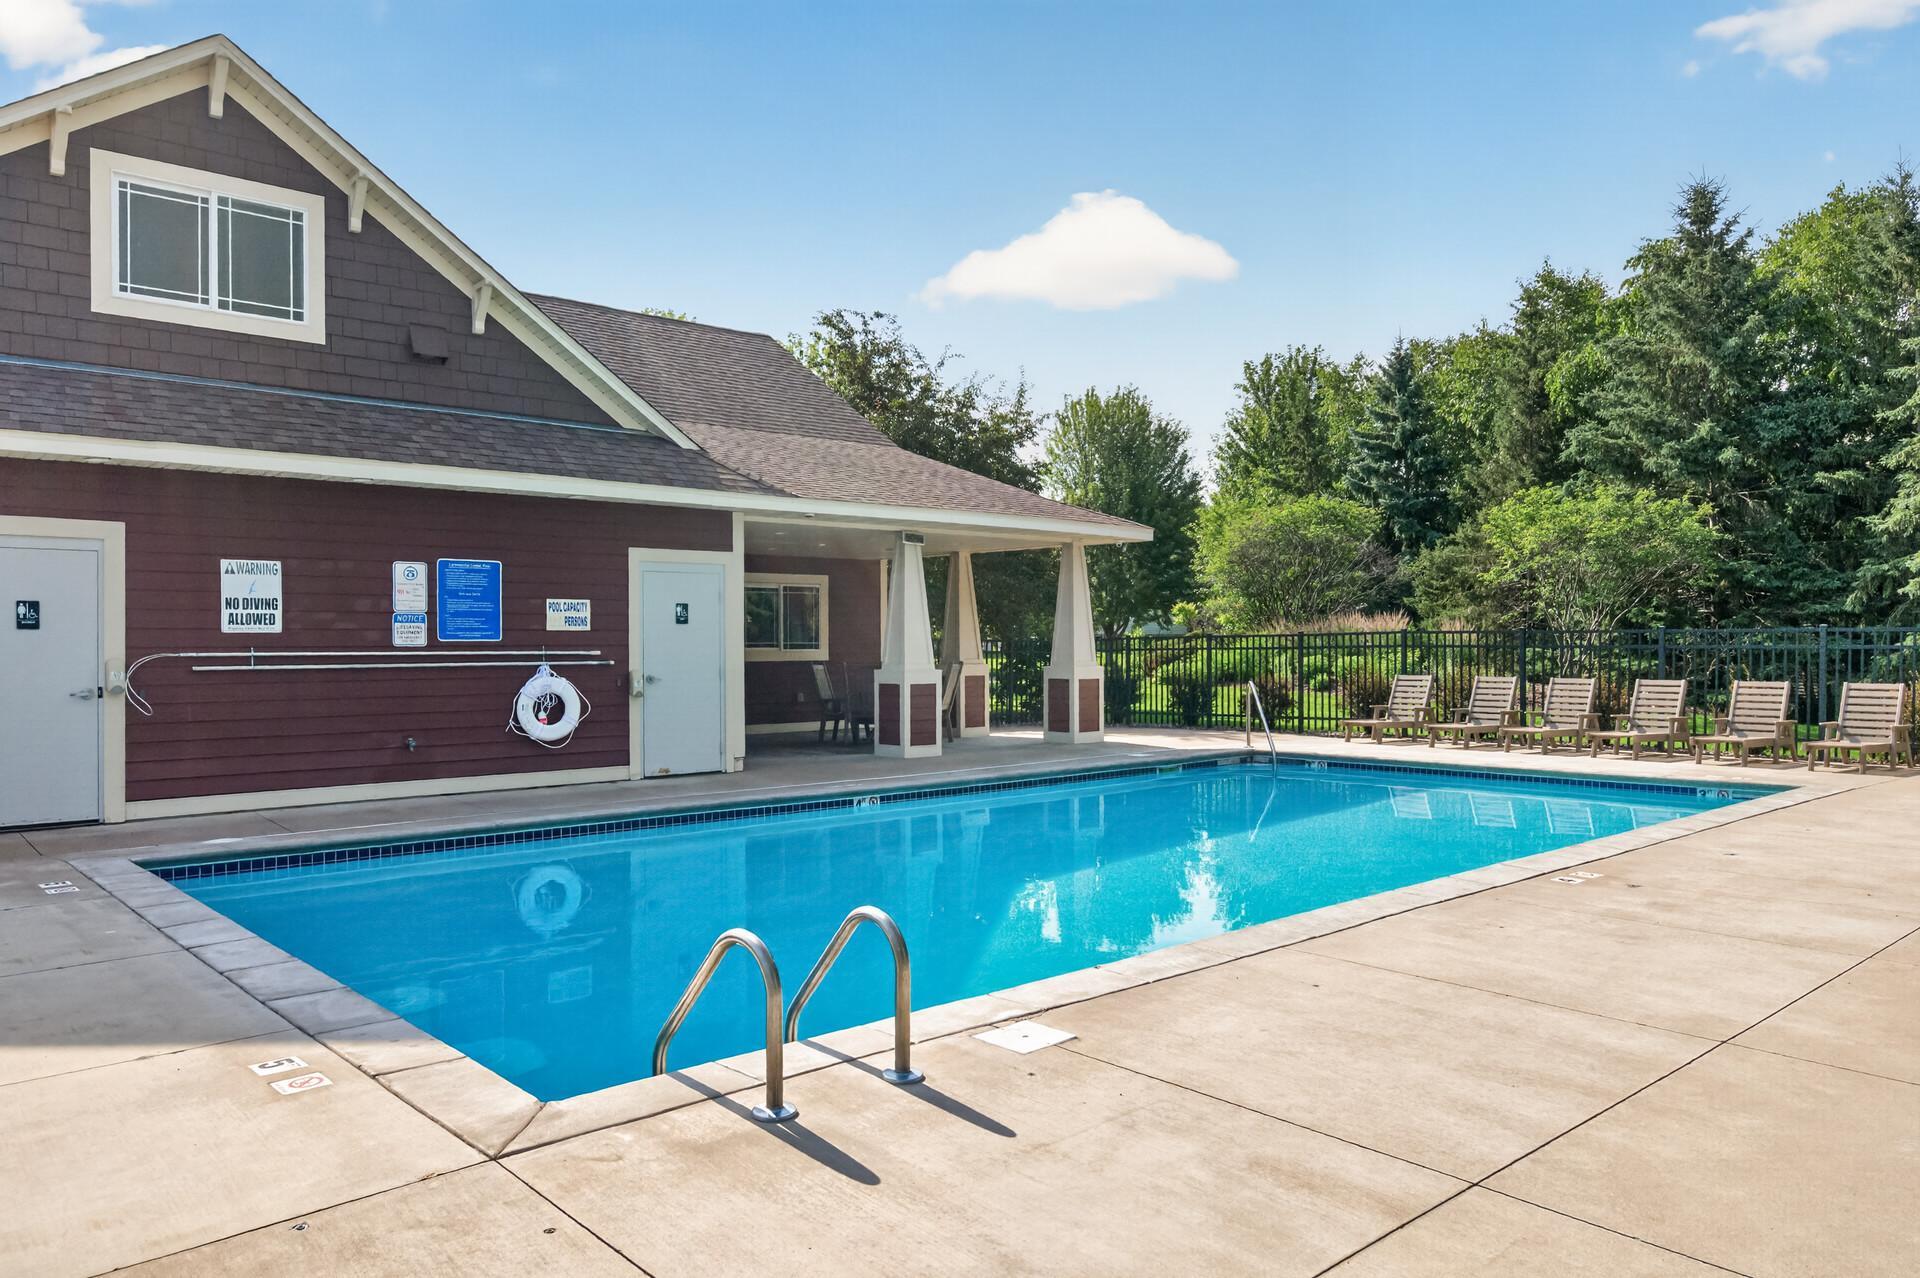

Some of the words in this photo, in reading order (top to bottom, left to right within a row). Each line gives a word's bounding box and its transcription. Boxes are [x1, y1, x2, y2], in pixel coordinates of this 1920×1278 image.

[236, 561, 279, 576] WARNING
[225, 597, 240, 610] NO
[242, 597, 279, 611] DIVING
[548, 601, 562, 612] POOL
[563, 601, 588, 613] CAPACITY
[228, 612, 276, 626] ALLOWED
[396, 614, 424, 623] NOTICE
[564, 615, 588, 627] PERSONS
